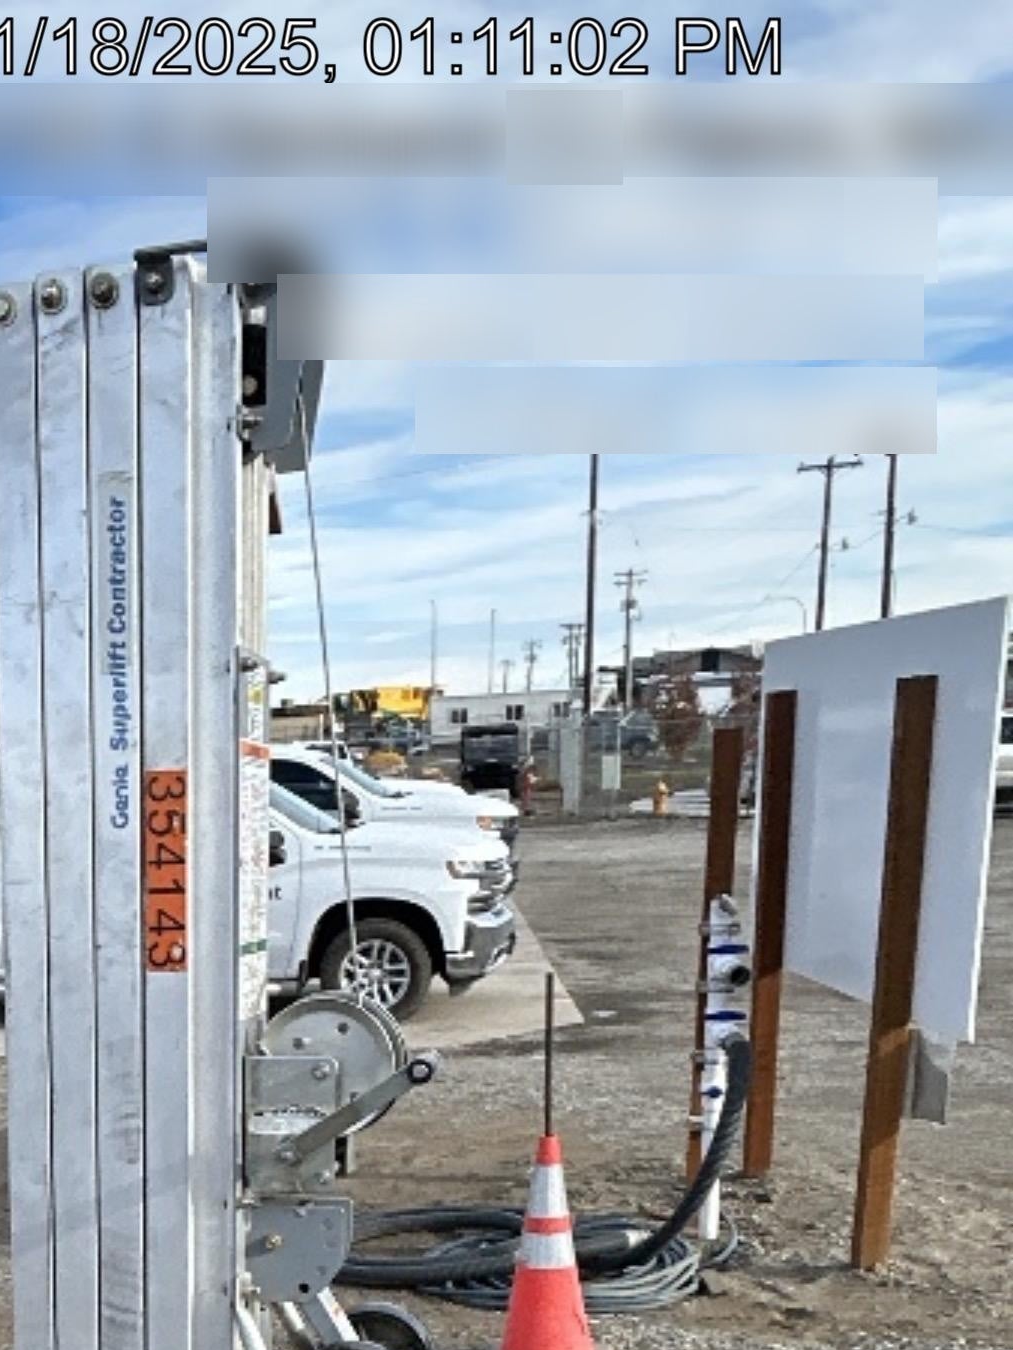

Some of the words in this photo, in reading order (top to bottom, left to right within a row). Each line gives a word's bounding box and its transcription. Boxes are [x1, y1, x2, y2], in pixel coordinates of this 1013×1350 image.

[107, 496, 126, 634] Contractor
[108, 641, 131, 751] Superlift
[110, 763, 129, 829] Genie
[147, 776, 185, 967] 354143
